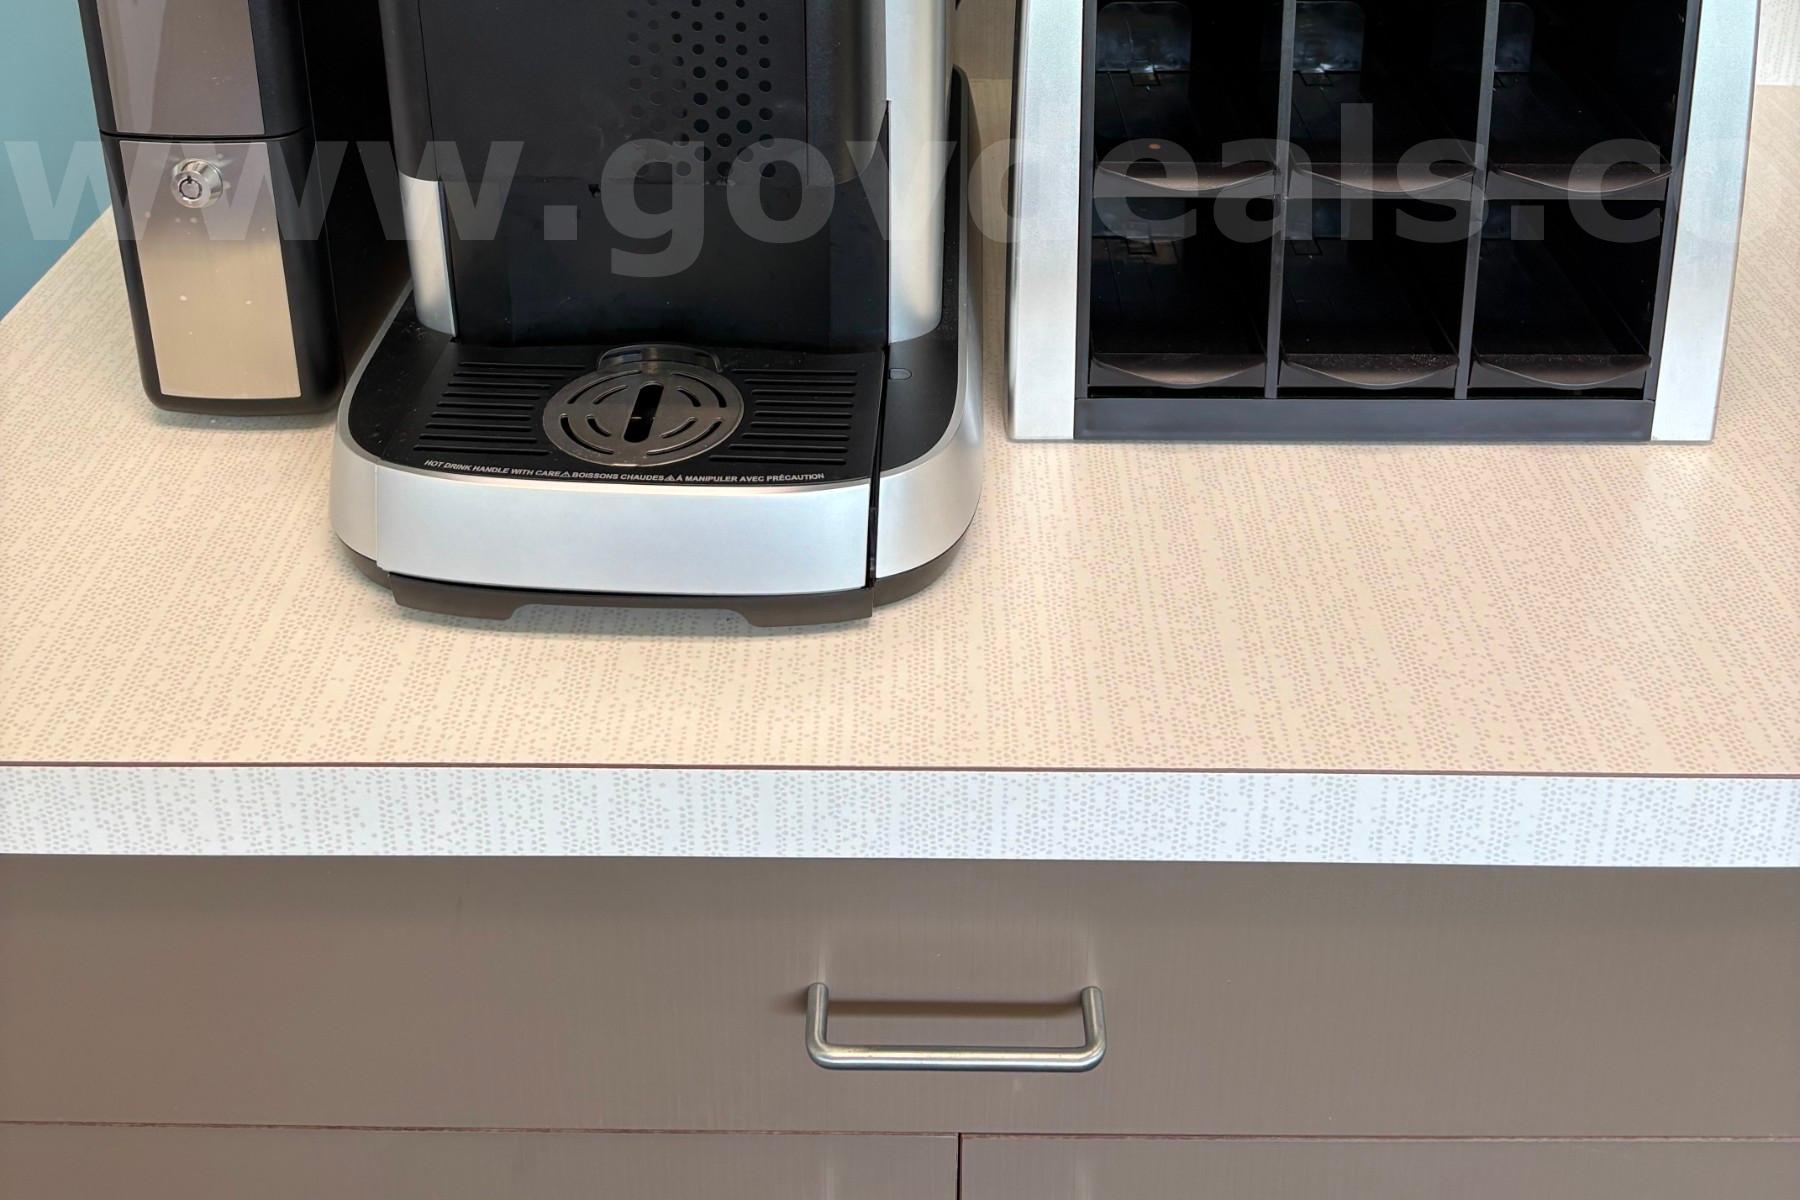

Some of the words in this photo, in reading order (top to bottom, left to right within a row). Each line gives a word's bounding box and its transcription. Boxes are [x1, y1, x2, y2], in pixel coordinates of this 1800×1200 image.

[424, 459, 443, 468] HOT
[443, 462, 472, 472] DRINK
[472, 465, 509, 474] HANDLE
[510, 468, 534, 476] WITH
[534, 470, 562, 478] CARE
[571, 472, 619, 480] BOISSONS
[620, 473, 665, 482] CHAUDES
[685, 474, 738, 482] MANIPULER
[739, 474, 765, 482] AVEC
[766, 472, 825, 482] PRÉCAUTION
